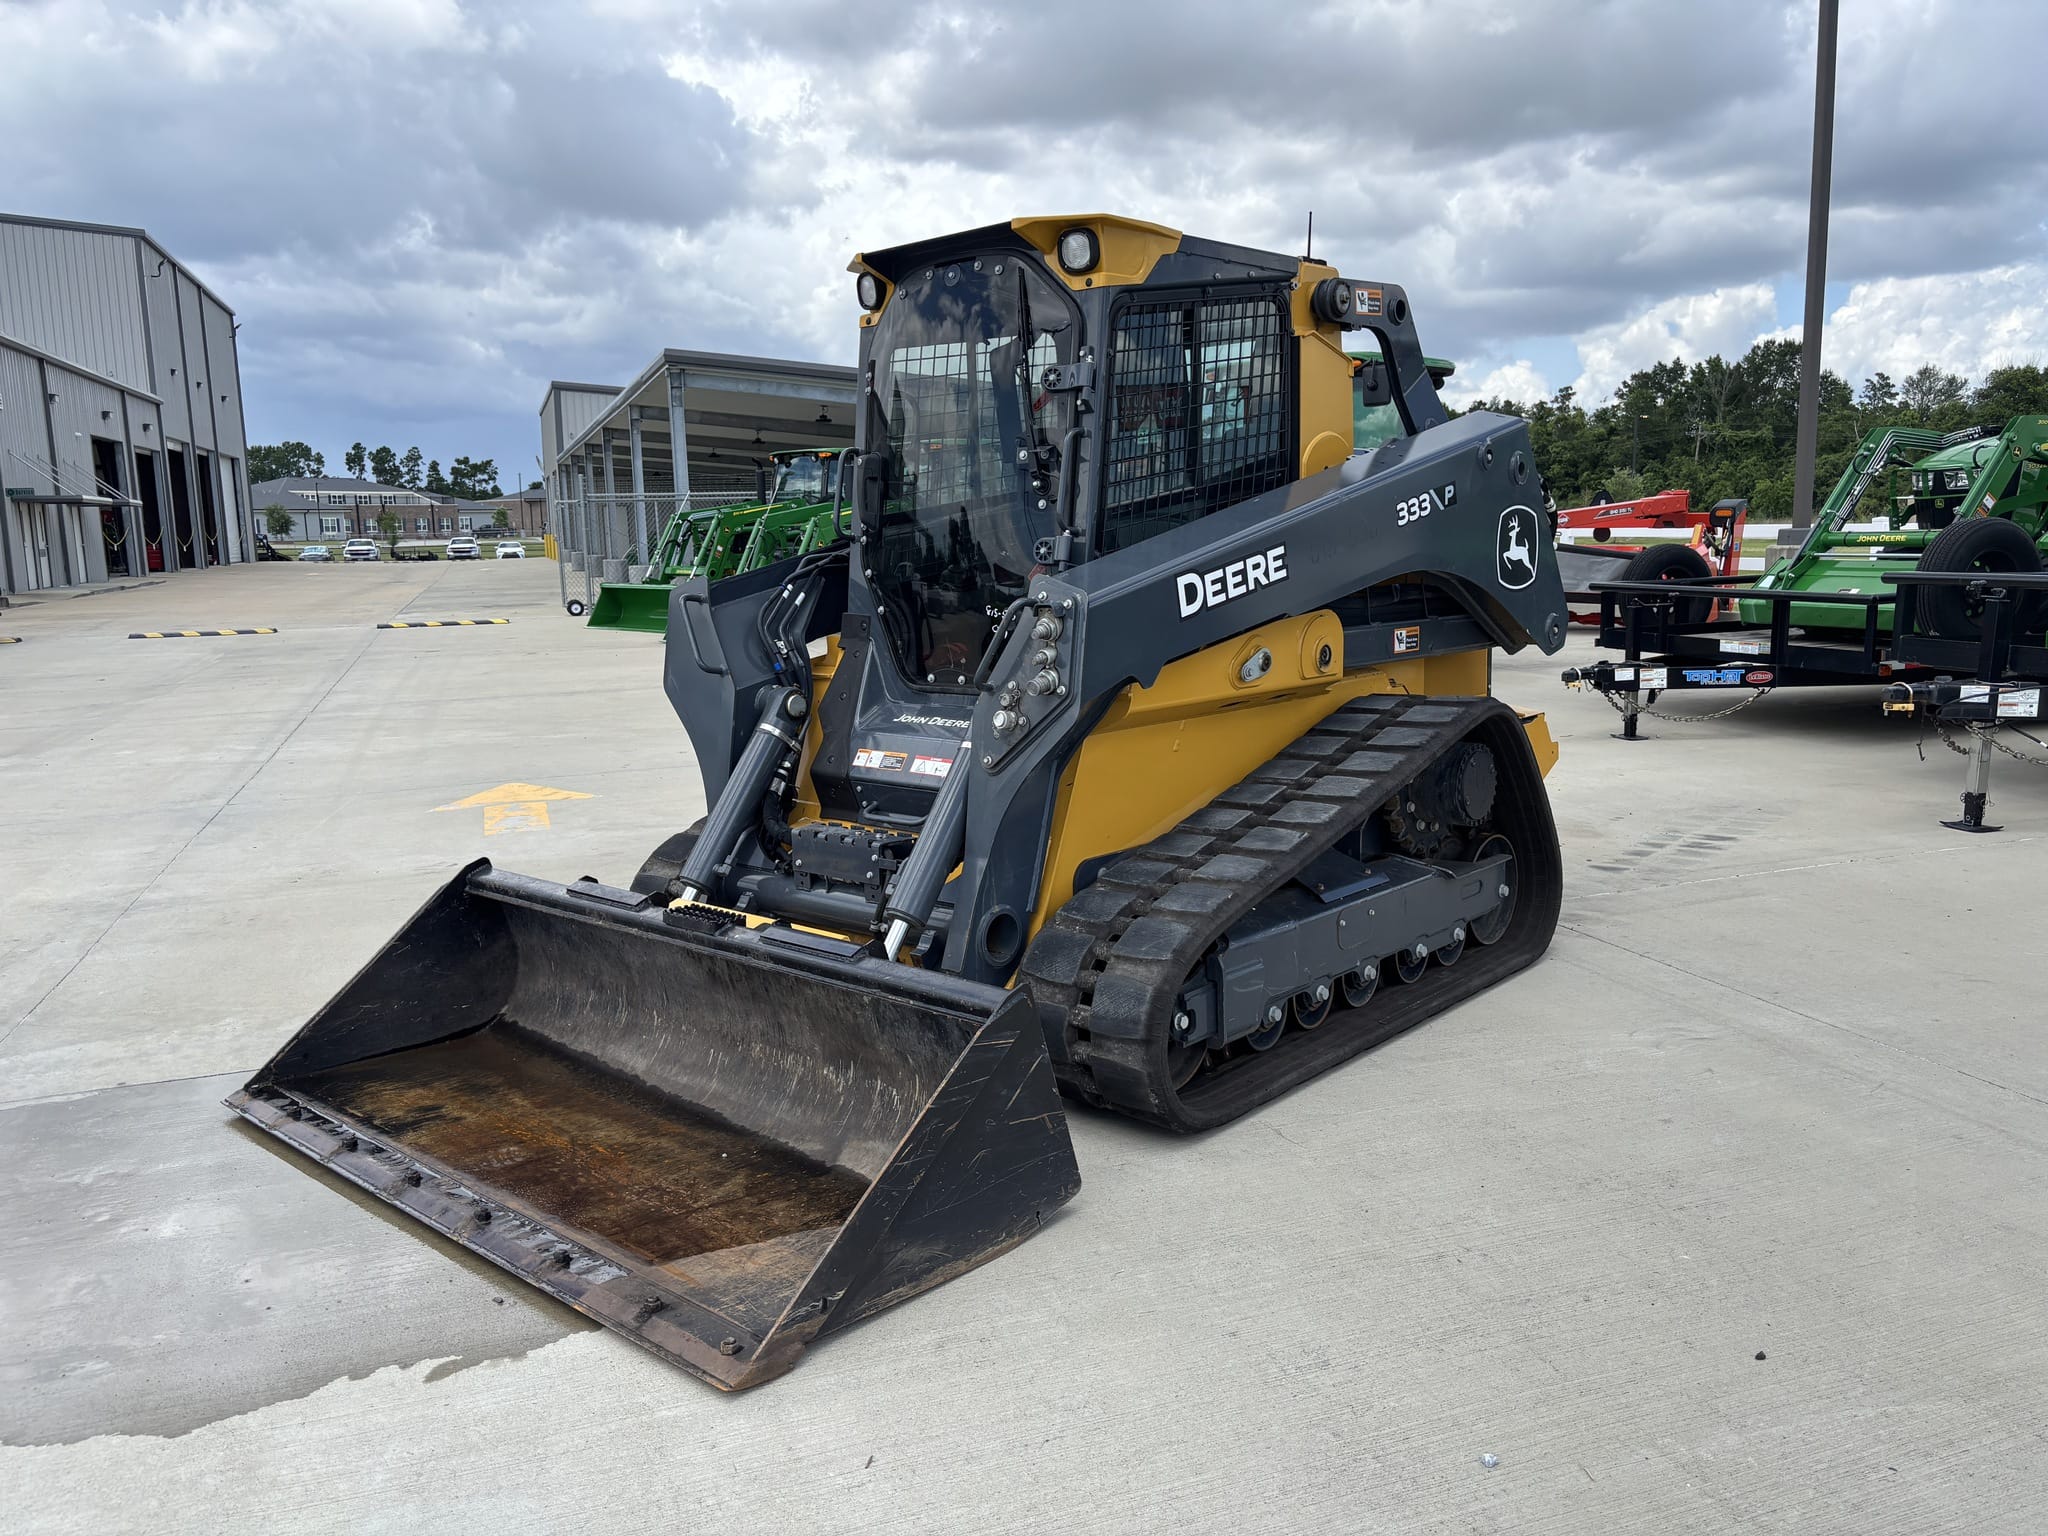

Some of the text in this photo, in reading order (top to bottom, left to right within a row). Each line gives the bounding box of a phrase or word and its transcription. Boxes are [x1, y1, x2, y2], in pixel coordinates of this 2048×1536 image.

[1856, 534, 1907, 543] JOHN DEERE
[1177, 545, 1287, 618] DEERE
[892, 713, 971, 728] JOHN DEERE
